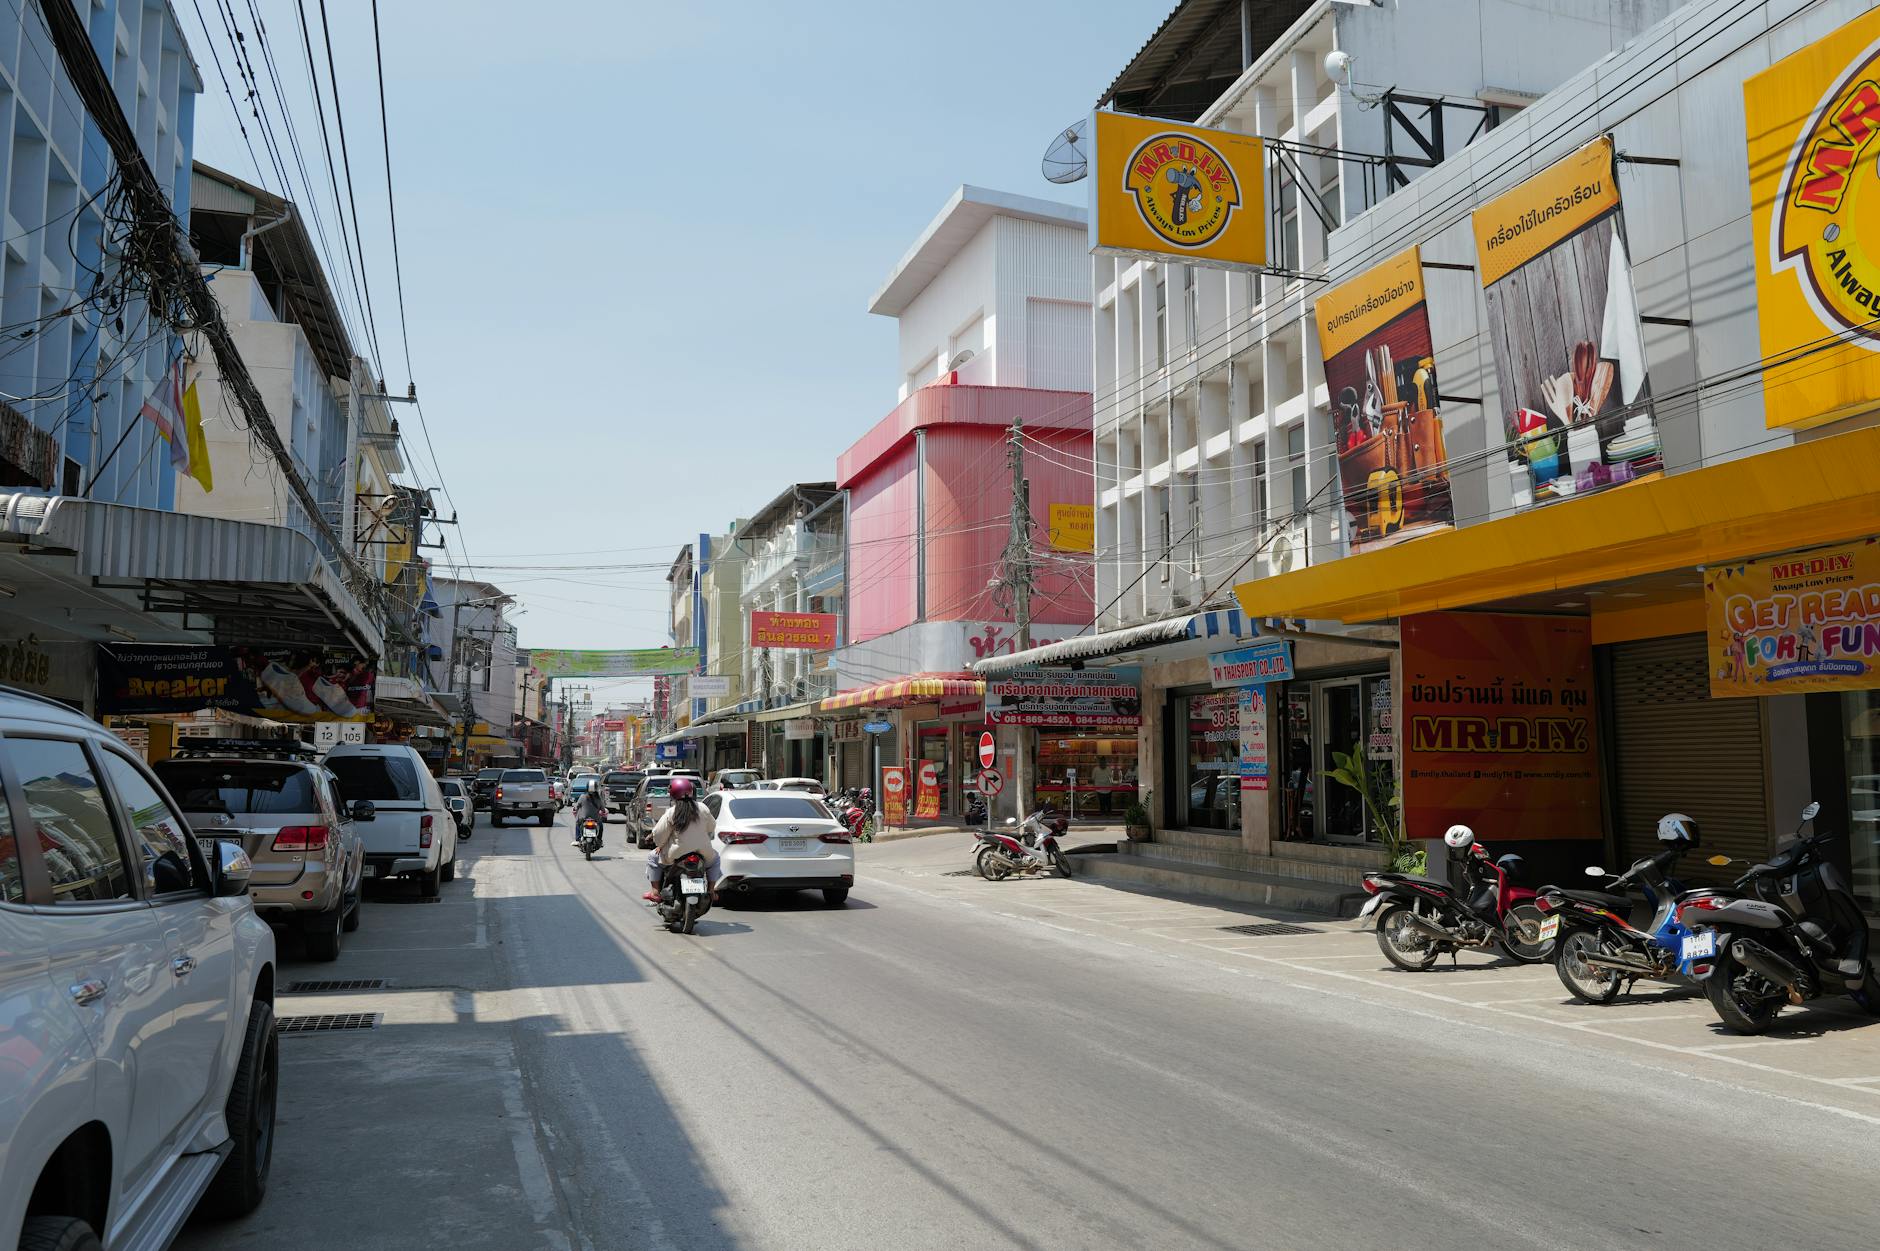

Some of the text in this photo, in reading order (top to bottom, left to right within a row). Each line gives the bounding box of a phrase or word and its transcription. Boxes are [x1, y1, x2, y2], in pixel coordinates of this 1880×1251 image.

[1146, 195, 1221, 237] Always Low Prices
[1486, 181, 1601, 251] เครื่องใช้ในครัวเรือน
[1327, 280, 1415, 333] อุปกรณ์เครื่องมือช่าง
[1773, 574, 1854, 591] Always Low Prices
[1727, 594, 1796, 633] GET
[1745, 623, 1880, 667] FOR FUN
[1223, 661, 1257, 680] THAISPORT
[128, 675, 229, 699] Breaker
[1411, 674, 1504, 705] ช้อปร้านนี้
[1511, 677, 1553, 705] มีแต่
[1560, 677, 1588, 712] คุ้ม
[321, 732, 333, 740] 12
[1004, 715, 1139, 726] 081-869-4520, 084-680-0995
[344, 733, 361, 741] 105
